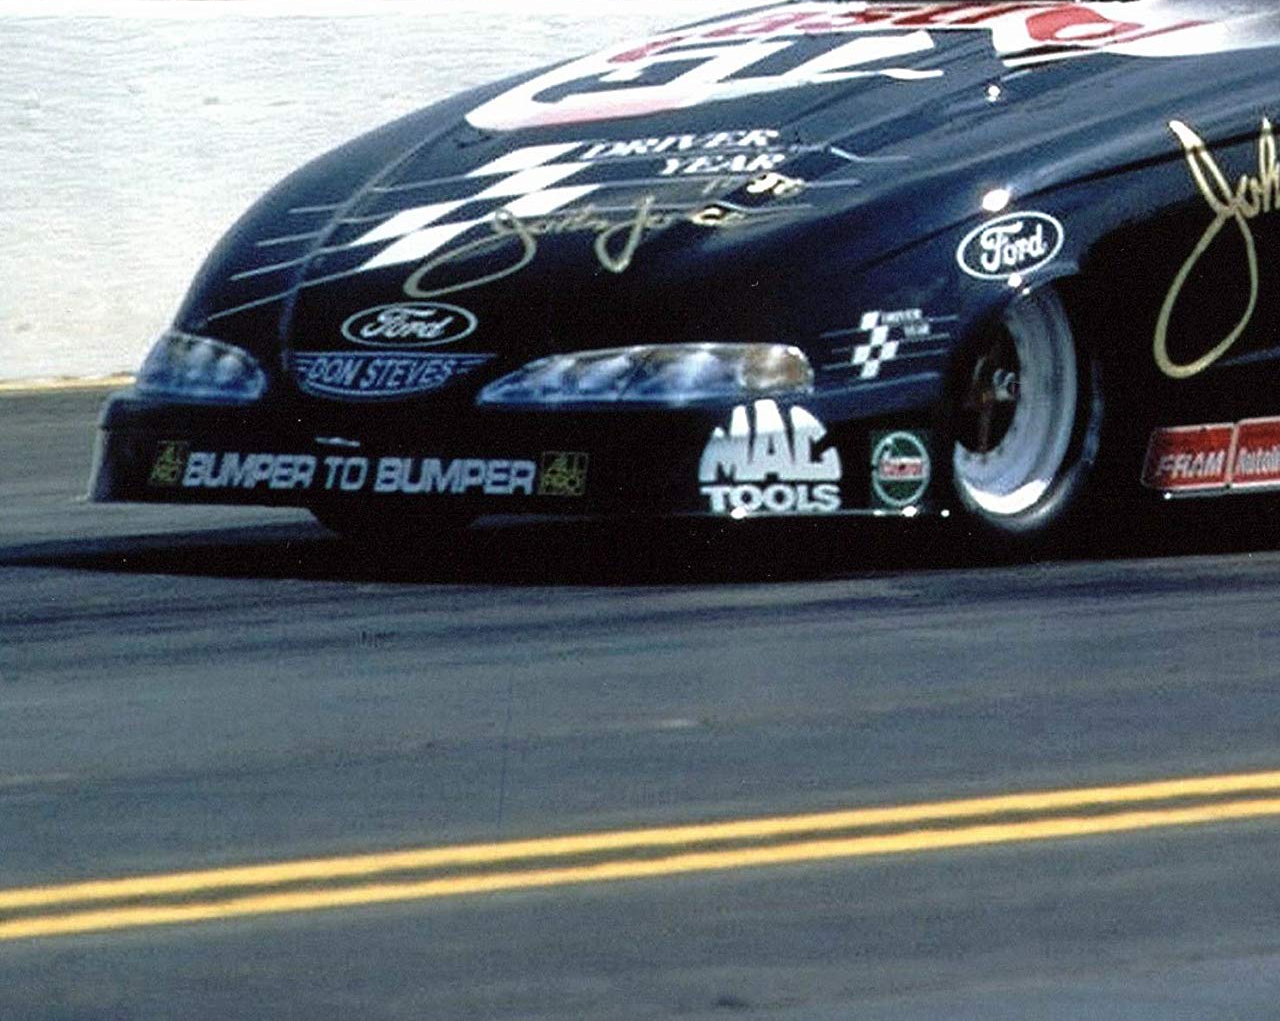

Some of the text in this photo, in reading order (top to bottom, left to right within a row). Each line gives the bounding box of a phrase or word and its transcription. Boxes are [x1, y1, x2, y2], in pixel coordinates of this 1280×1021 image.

[980, 220, 1048, 272] Ford
[359, 307, 455, 339] Ford
[698, 398, 842, 483] MAC
[182, 450, 316, 490] BUMPER
[323, 455, 367, 492] TO
[373, 456, 538, 495] BUMPER
[1156, 448, 1226, 477] FRAM
[699, 484, 842, 513] TOOLS
